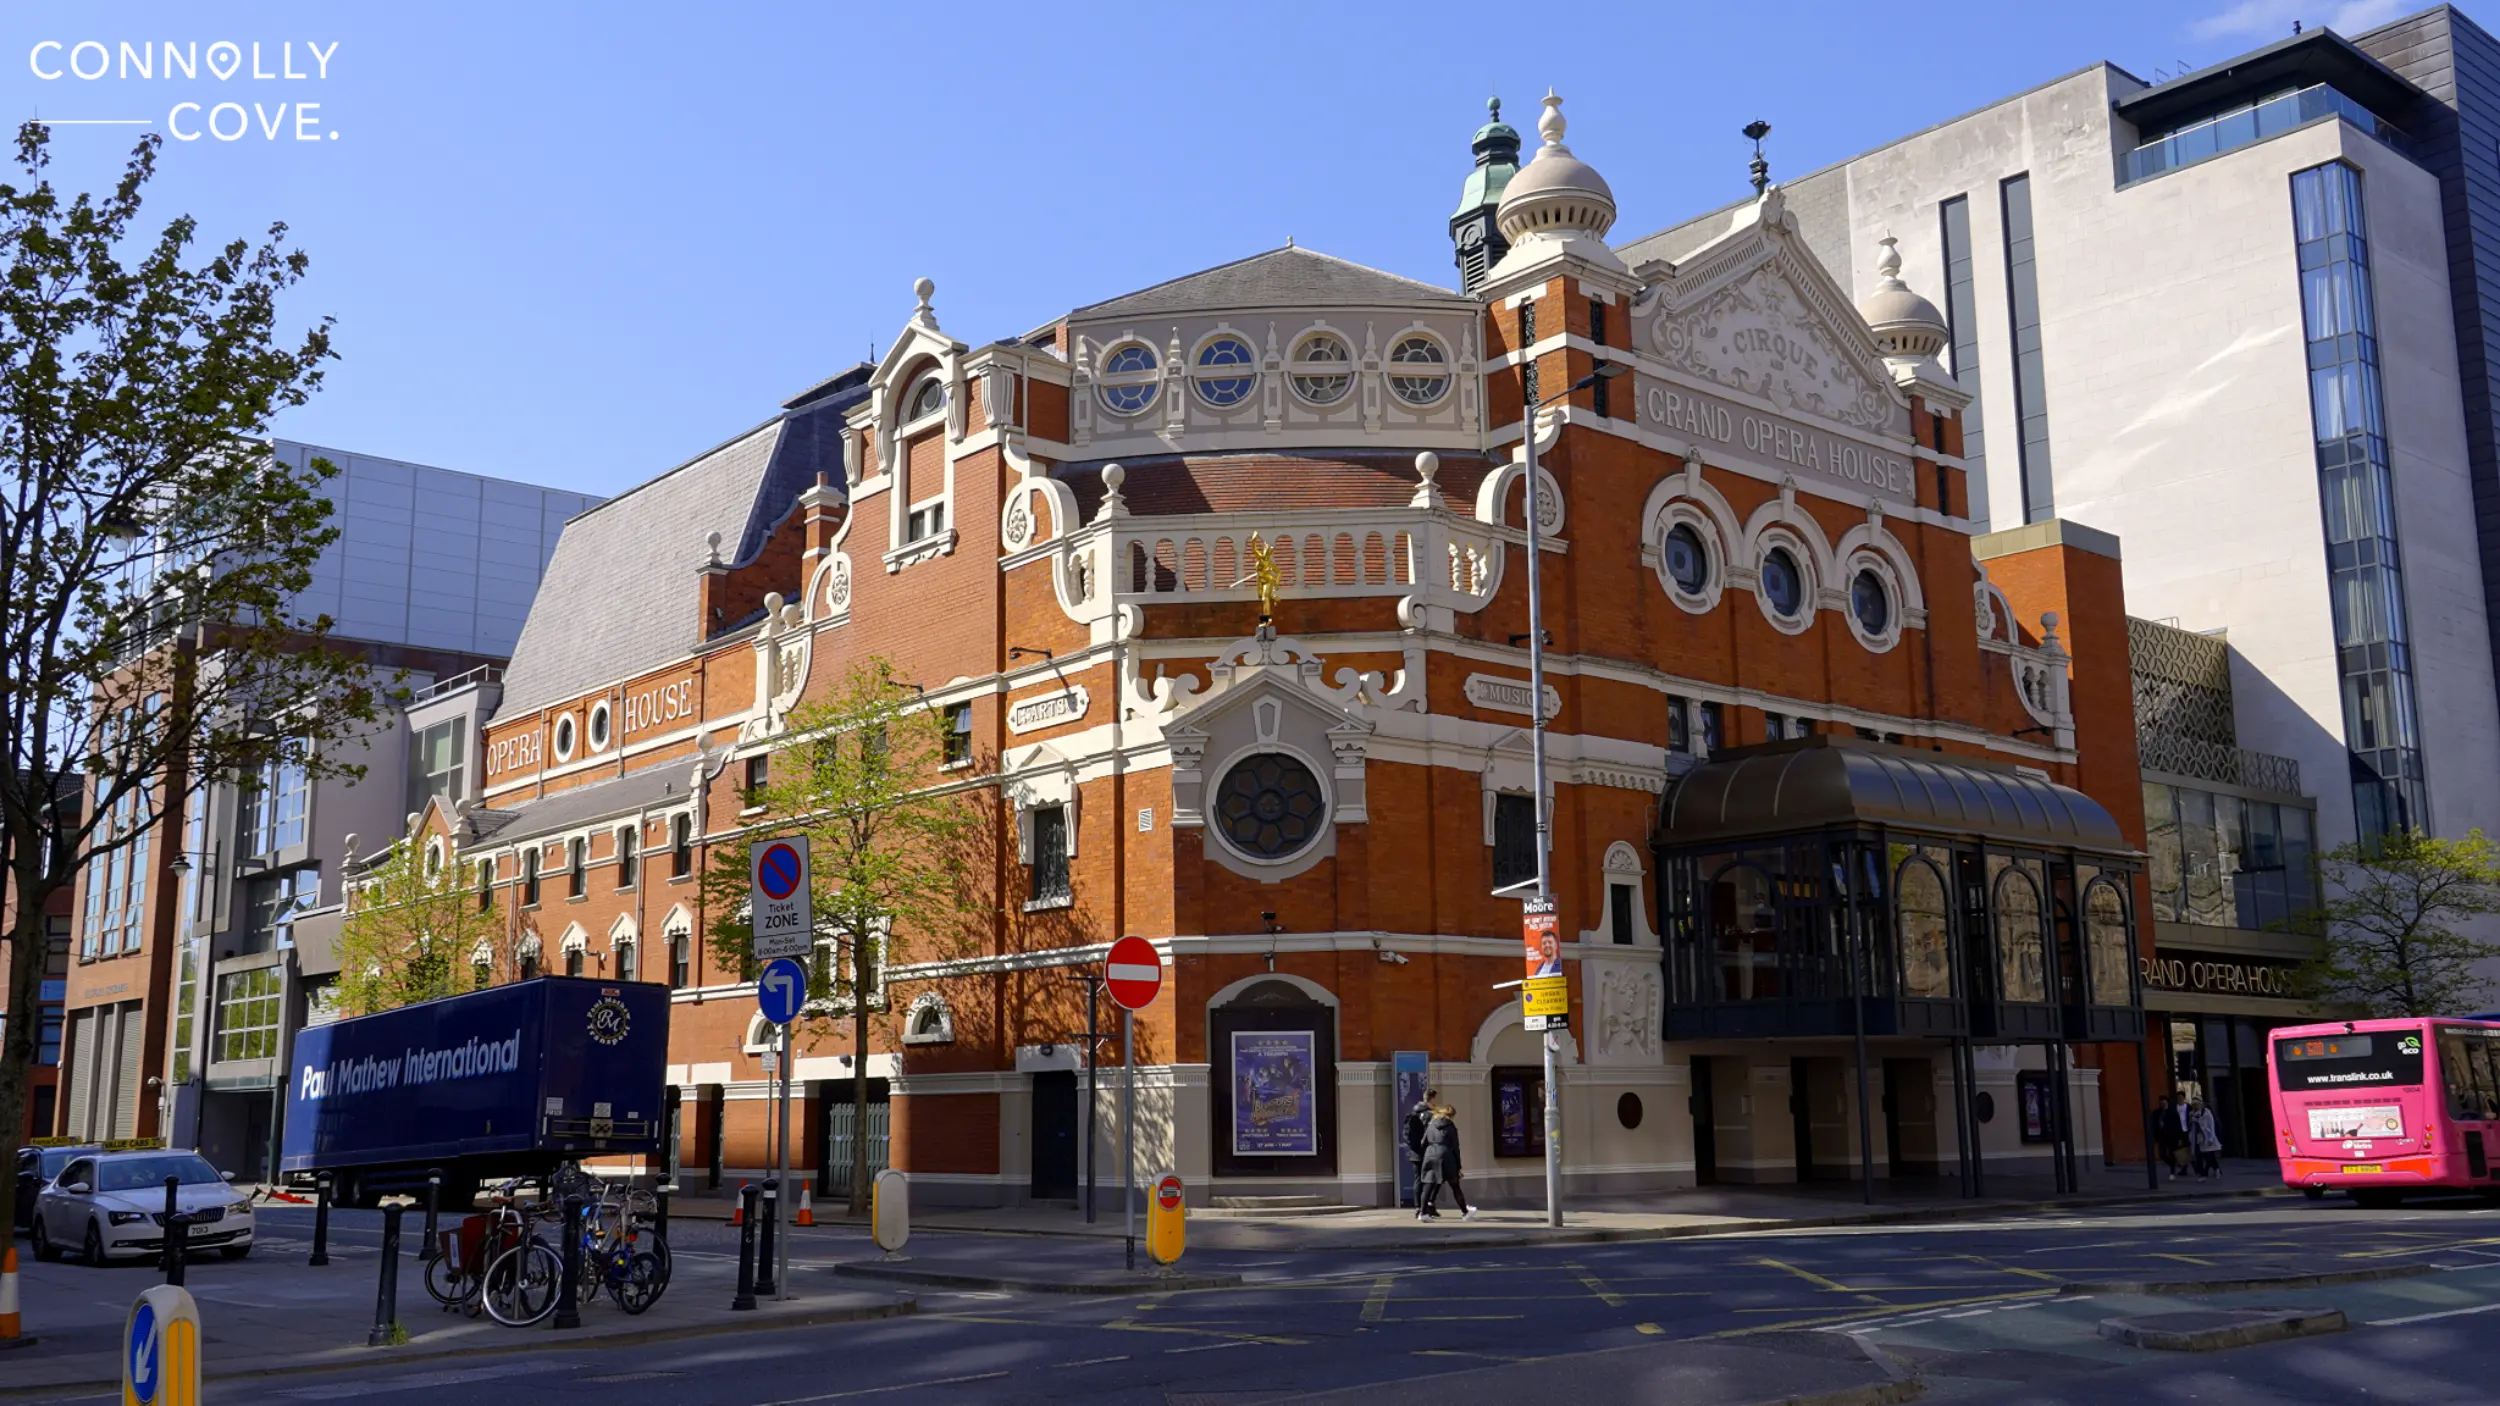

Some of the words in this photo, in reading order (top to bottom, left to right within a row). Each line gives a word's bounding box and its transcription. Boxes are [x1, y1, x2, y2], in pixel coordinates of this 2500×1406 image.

[1733, 327, 1818, 380] CIRQUE
[1648, 387, 1732, 443] GRAND
[1742, 416, 1821, 470] OPERA
[1828, 441, 1901, 493] HOUSE
[486, 730, 541, 776] OPERA
[624, 679, 693, 733] HOUSE
[768, 902, 794, 913] Ticket
[1524, 902, 1553, 914] Moore
[765, 912, 799, 929] ZONE
[2139, 957, 2186, 987] RAND
[2191, 961, 2249, 991] OPERA
[587, 999, 603, 1018] Paul
[587, 1023, 631, 1045] Transport
[2402, 1047, 2419, 1055] eco
[301, 1061, 336, 1101] Paul
[337, 1054, 402, 1096] Mathew
[403, 1028, 521, 1086] International
[2307, 1070, 2393, 1083] www.translink.co.uk
[129, 1138, 149, 1147] CABS
